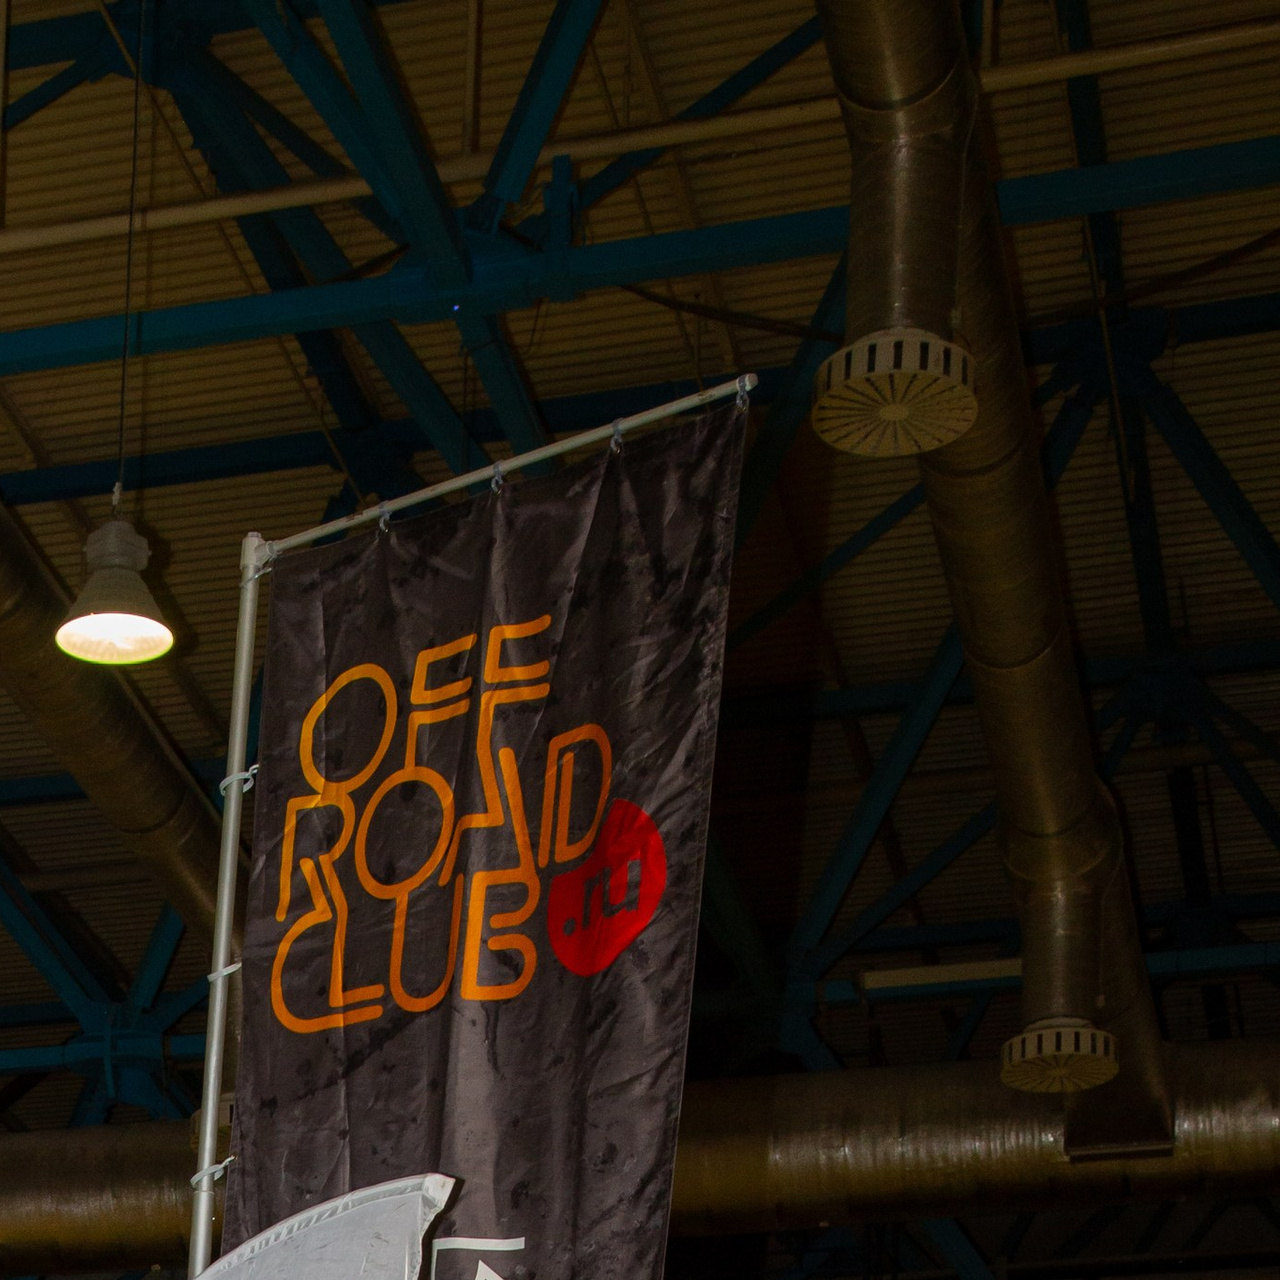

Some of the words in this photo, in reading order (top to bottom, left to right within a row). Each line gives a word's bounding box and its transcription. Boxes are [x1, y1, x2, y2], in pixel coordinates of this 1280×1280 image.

[299, 614, 551, 792] OFF
[276, 722, 612, 922] ROAD
[271, 866, 541, 1034] CLUB
